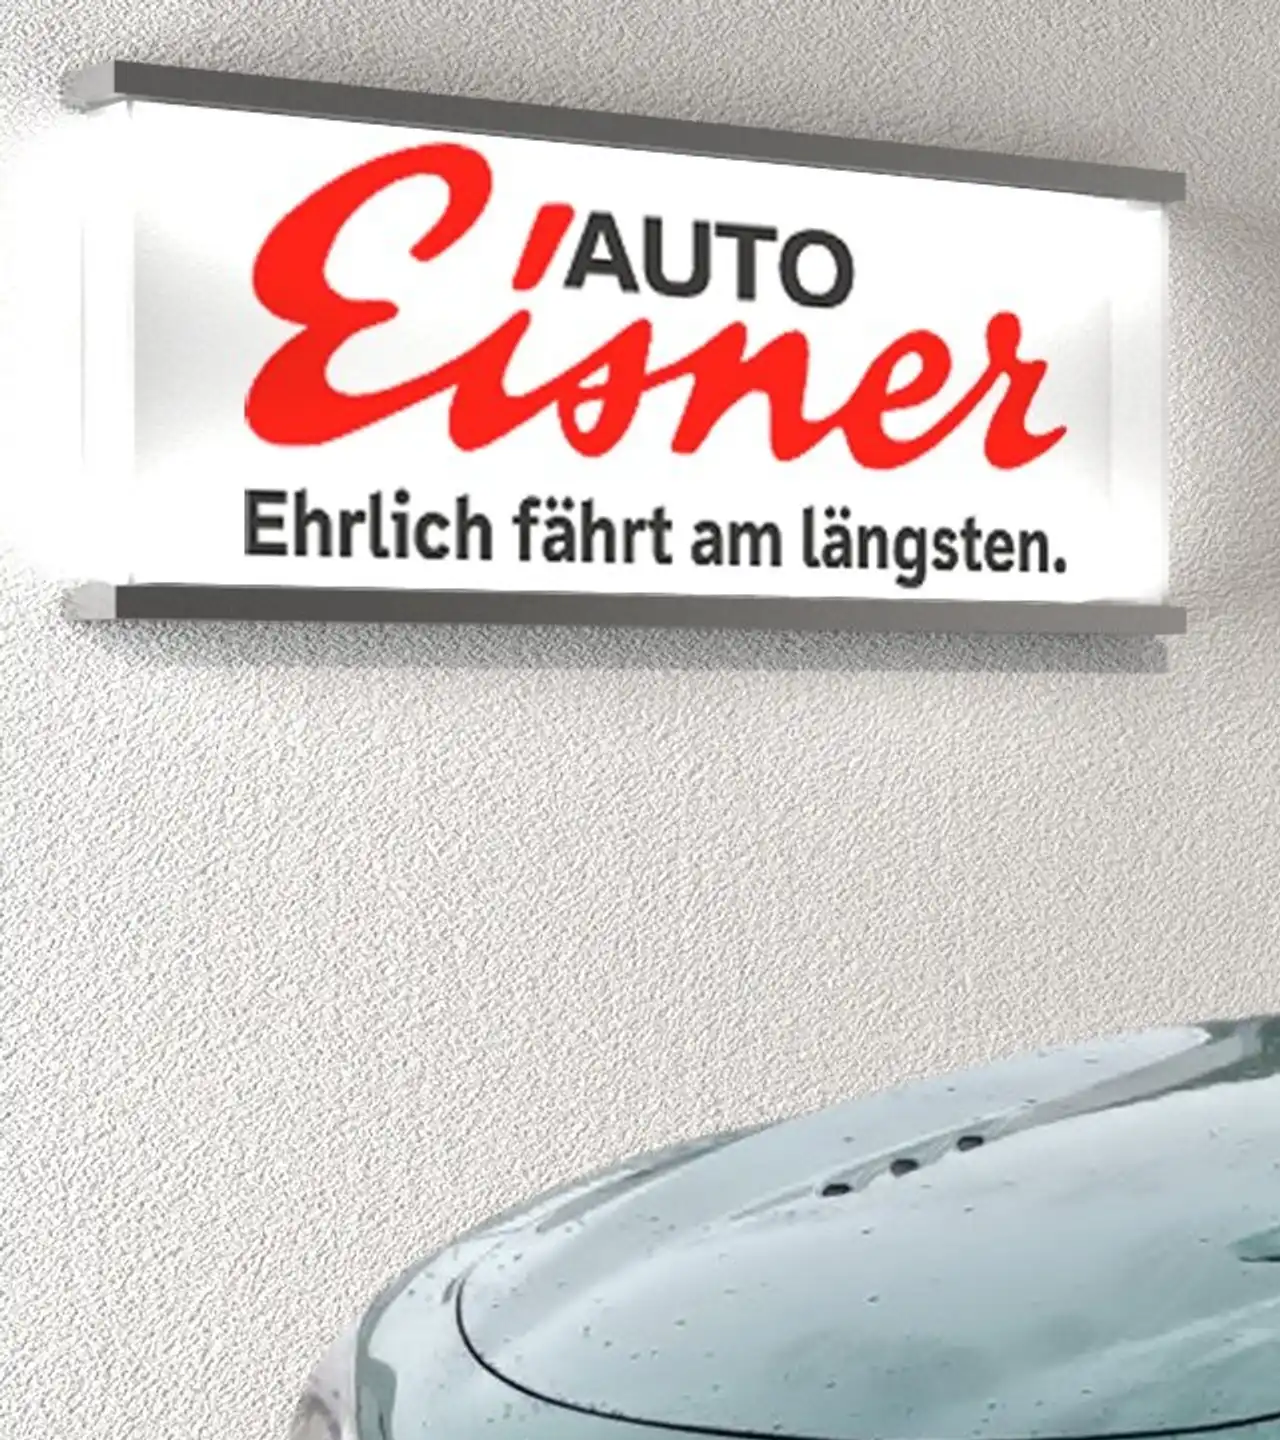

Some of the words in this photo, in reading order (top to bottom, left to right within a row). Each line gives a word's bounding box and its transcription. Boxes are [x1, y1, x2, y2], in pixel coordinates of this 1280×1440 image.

[244, 142, 1067, 471] Eisner
[563, 211, 855, 309] AUTO
[244, 488, 493, 562] Ehrlich
[512, 496, 673, 565] fährt
[691, 520, 782, 567] am
[802, 506, 1067, 589] längsten.
